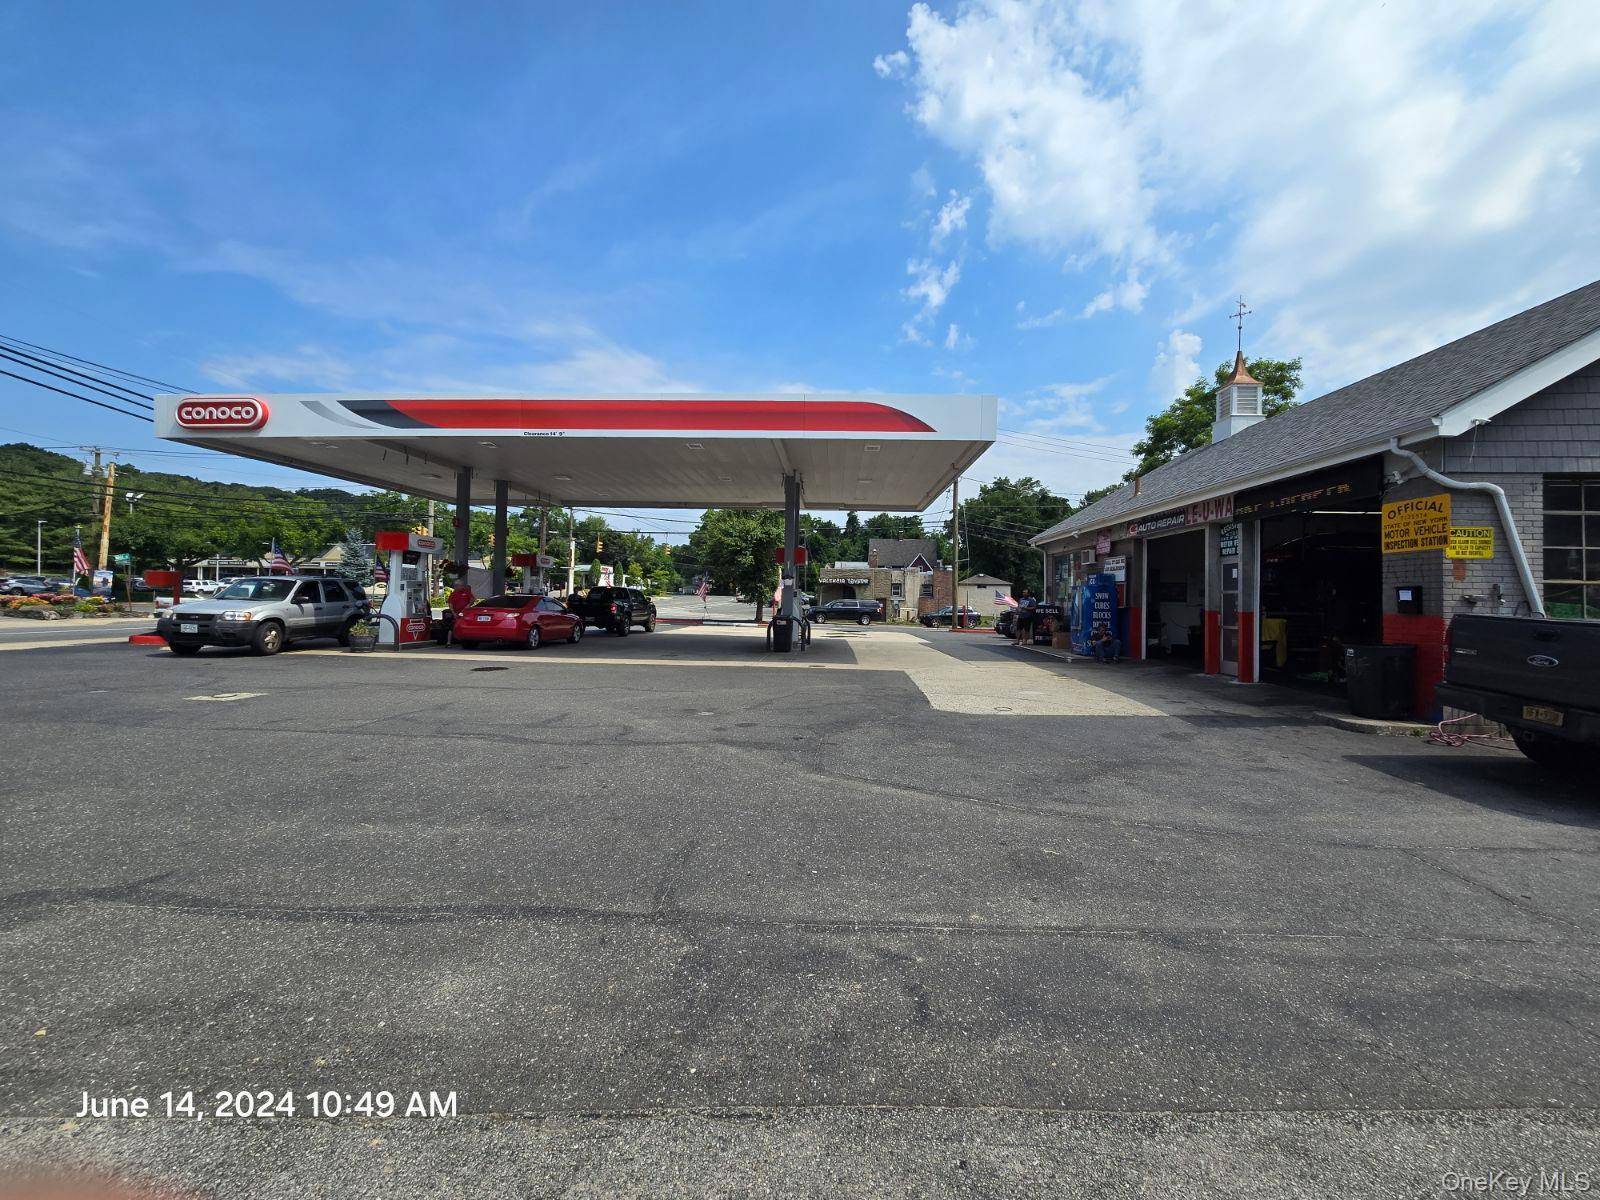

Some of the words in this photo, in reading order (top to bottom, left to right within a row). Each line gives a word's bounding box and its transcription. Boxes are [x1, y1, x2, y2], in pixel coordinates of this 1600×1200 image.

[1388, 501, 1444, 520] OFFICIAL
[1138, 521, 1157, 532] AUTO
[1157, 514, 1185, 529] REPAIR
[1431, 516, 1448, 524] YORK
[1385, 528, 1410, 540] MOTOR
[1414, 523, 1448, 536] VEHICLE
[1450, 529, 1490, 538] CAUTION
[1384, 538, 1418, 550] INSPECTION
[1421, 534, 1448, 547] STATION
[1093, 611, 1112, 619] BLOCKS
